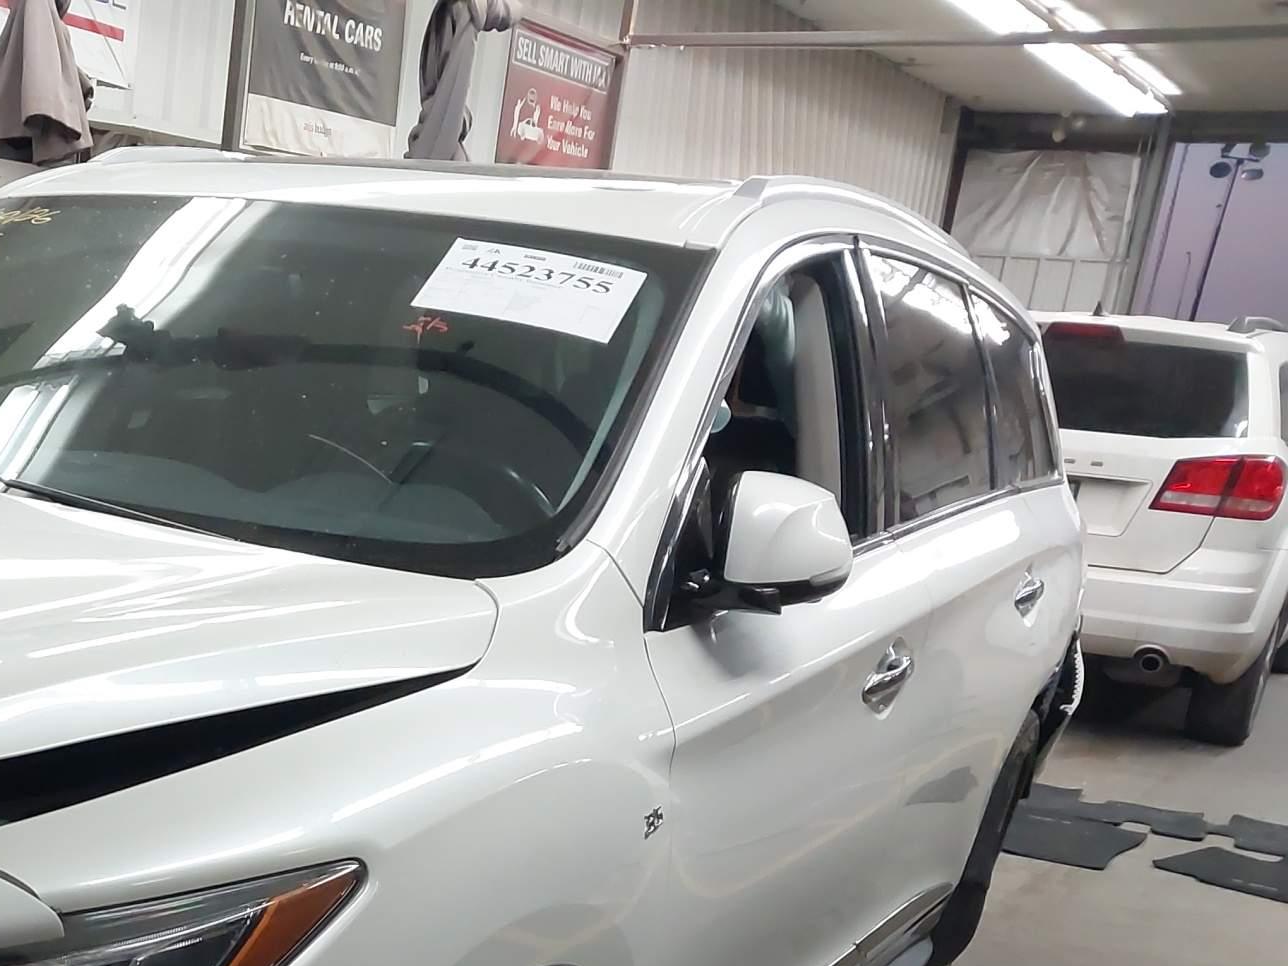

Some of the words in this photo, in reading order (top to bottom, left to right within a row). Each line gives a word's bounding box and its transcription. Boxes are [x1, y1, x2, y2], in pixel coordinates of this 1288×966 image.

[284, 0, 340, 39] RENTAL
[345, 19, 383, 51] CARS
[517, 37, 537, 64] SELL
[538, 46, 570, 75] SMART
[571, 57, 592, 84] WITH
[550, 96, 562, 112] We
[562, 99, 580, 118] Help
[580, 105, 592, 120] You
[547, 116, 565, 132] Earn
[565, 120, 582, 137] More
[583, 126, 595, 140] For
[546, 135, 561, 151] Your
[562, 139, 588, 158] Vehicle
[461, 257, 614, 295] 44523755
